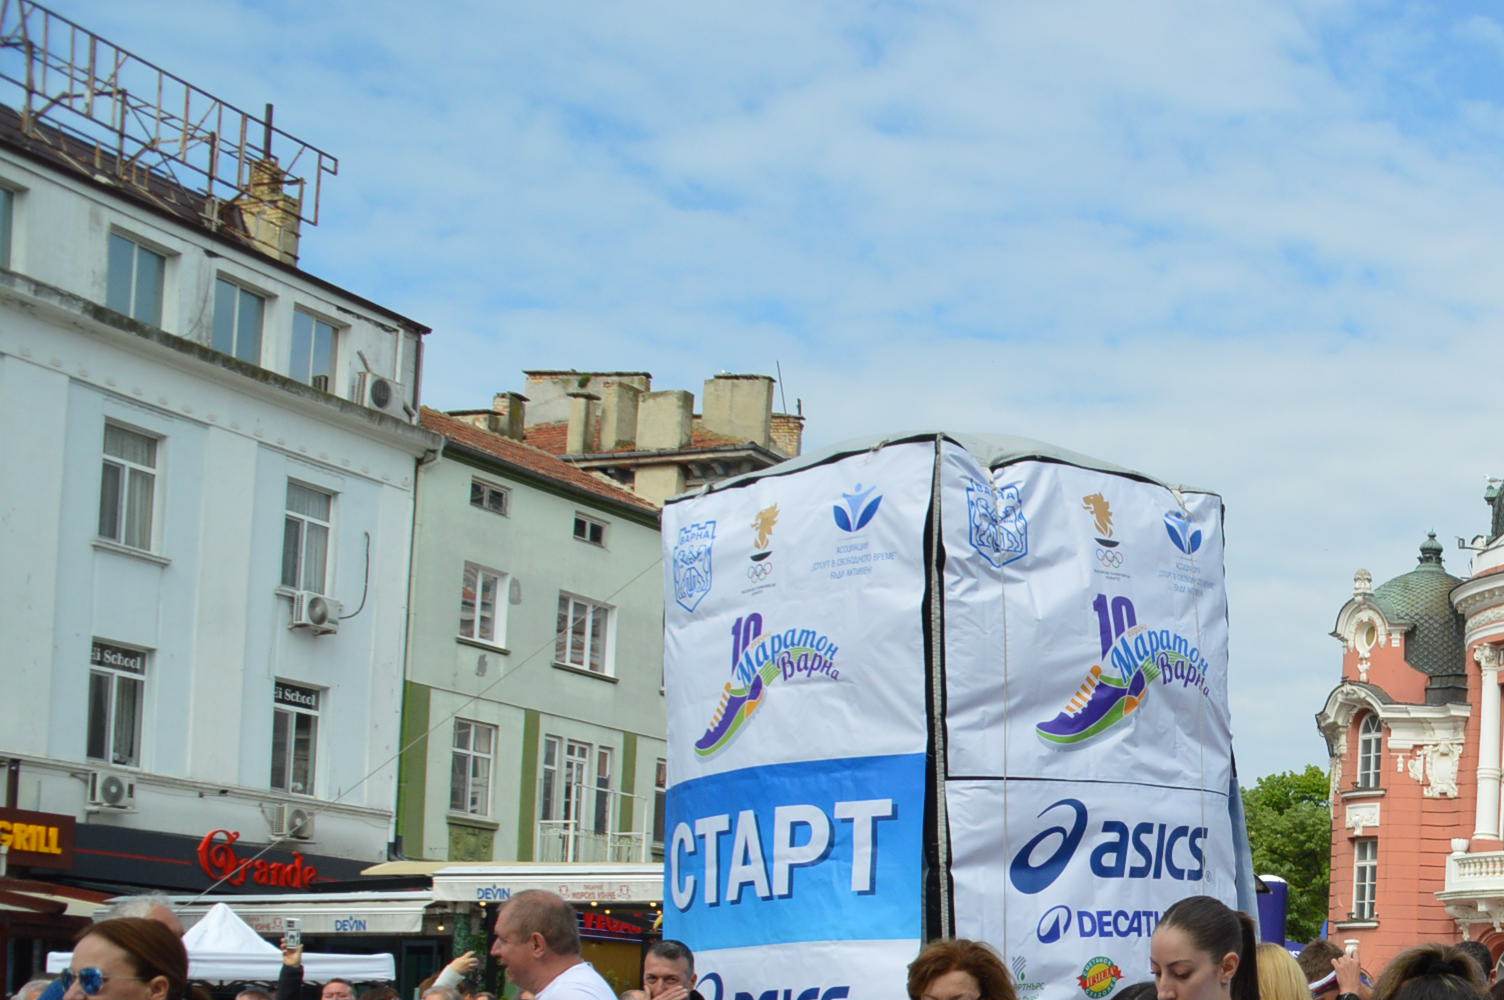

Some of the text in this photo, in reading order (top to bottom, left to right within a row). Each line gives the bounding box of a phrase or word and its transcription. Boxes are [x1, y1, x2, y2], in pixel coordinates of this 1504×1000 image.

[103, 650, 141, 669] School
[737, 628, 839, 690] Маратон
[777, 651, 840, 681] Варна
[1111, 629, 1209, 684] Маратон
[1157, 652, 1210, 697] Варна
[284, 689, 316, 705] School
[0, 819, 62, 854] GRILL
[197, 829, 318, 888] Grande
[671, 799, 897, 911] СТАРТ
[477, 886, 511, 900] DEVIN
[335, 917, 367, 931] DEVIN
